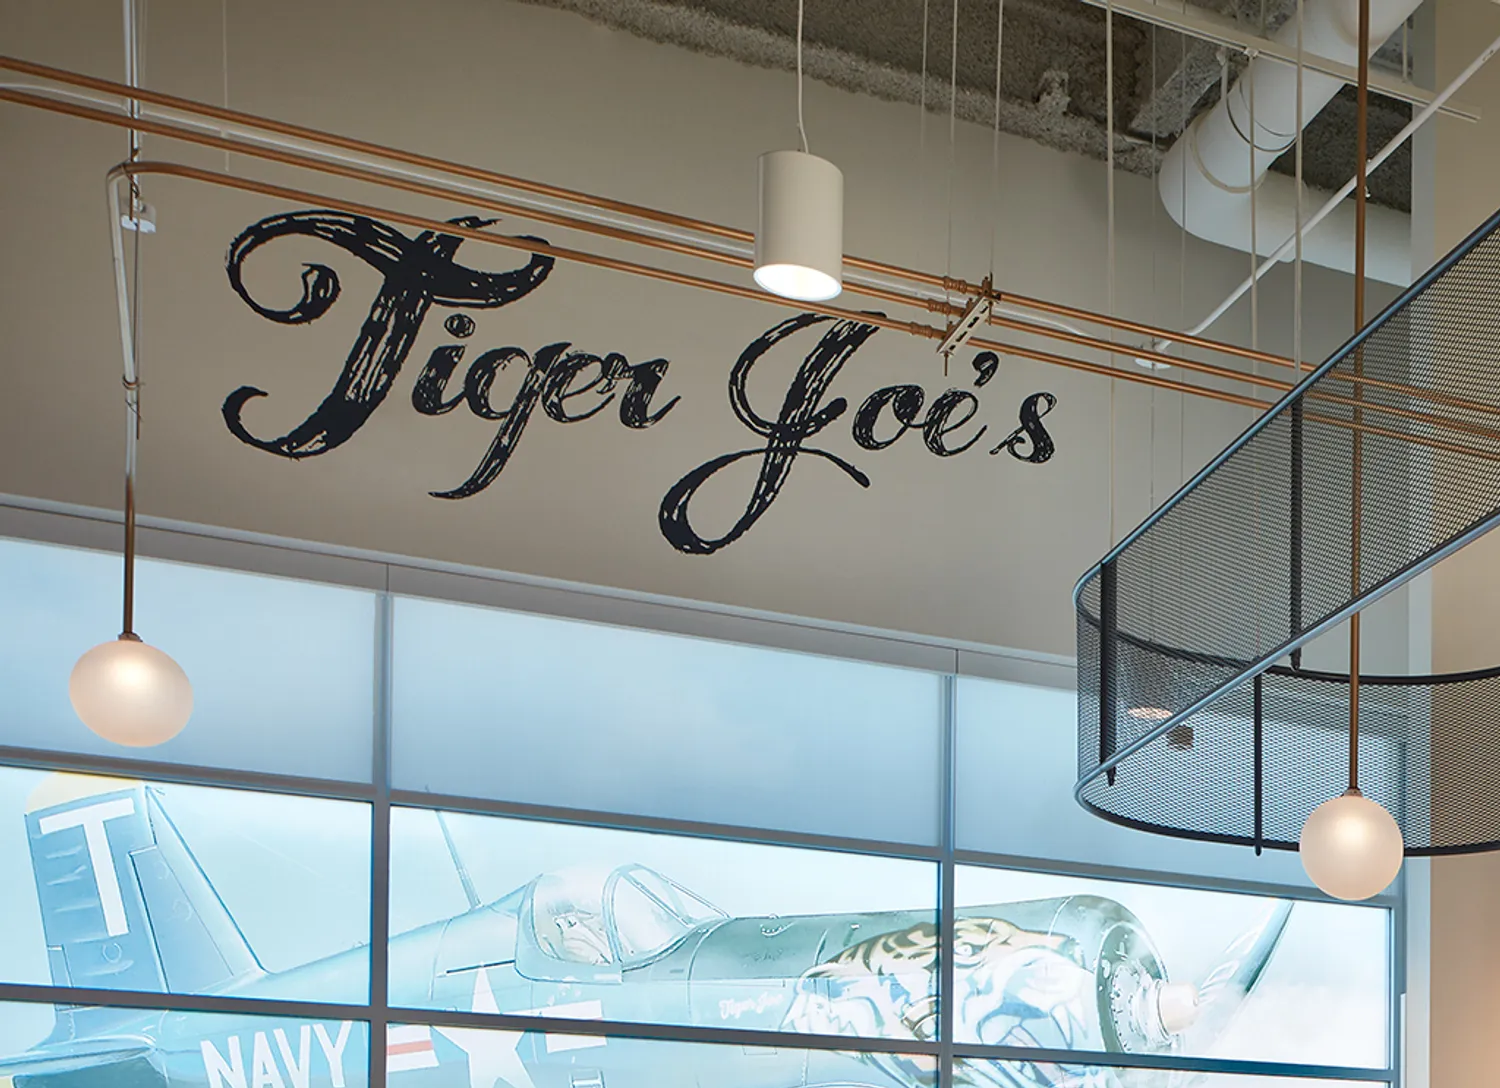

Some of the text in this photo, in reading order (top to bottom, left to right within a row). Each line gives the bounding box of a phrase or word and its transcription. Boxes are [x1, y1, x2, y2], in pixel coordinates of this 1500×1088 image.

[222, 209, 1059, 556] Tiger Joe's
[40, 796, 136, 936] T
